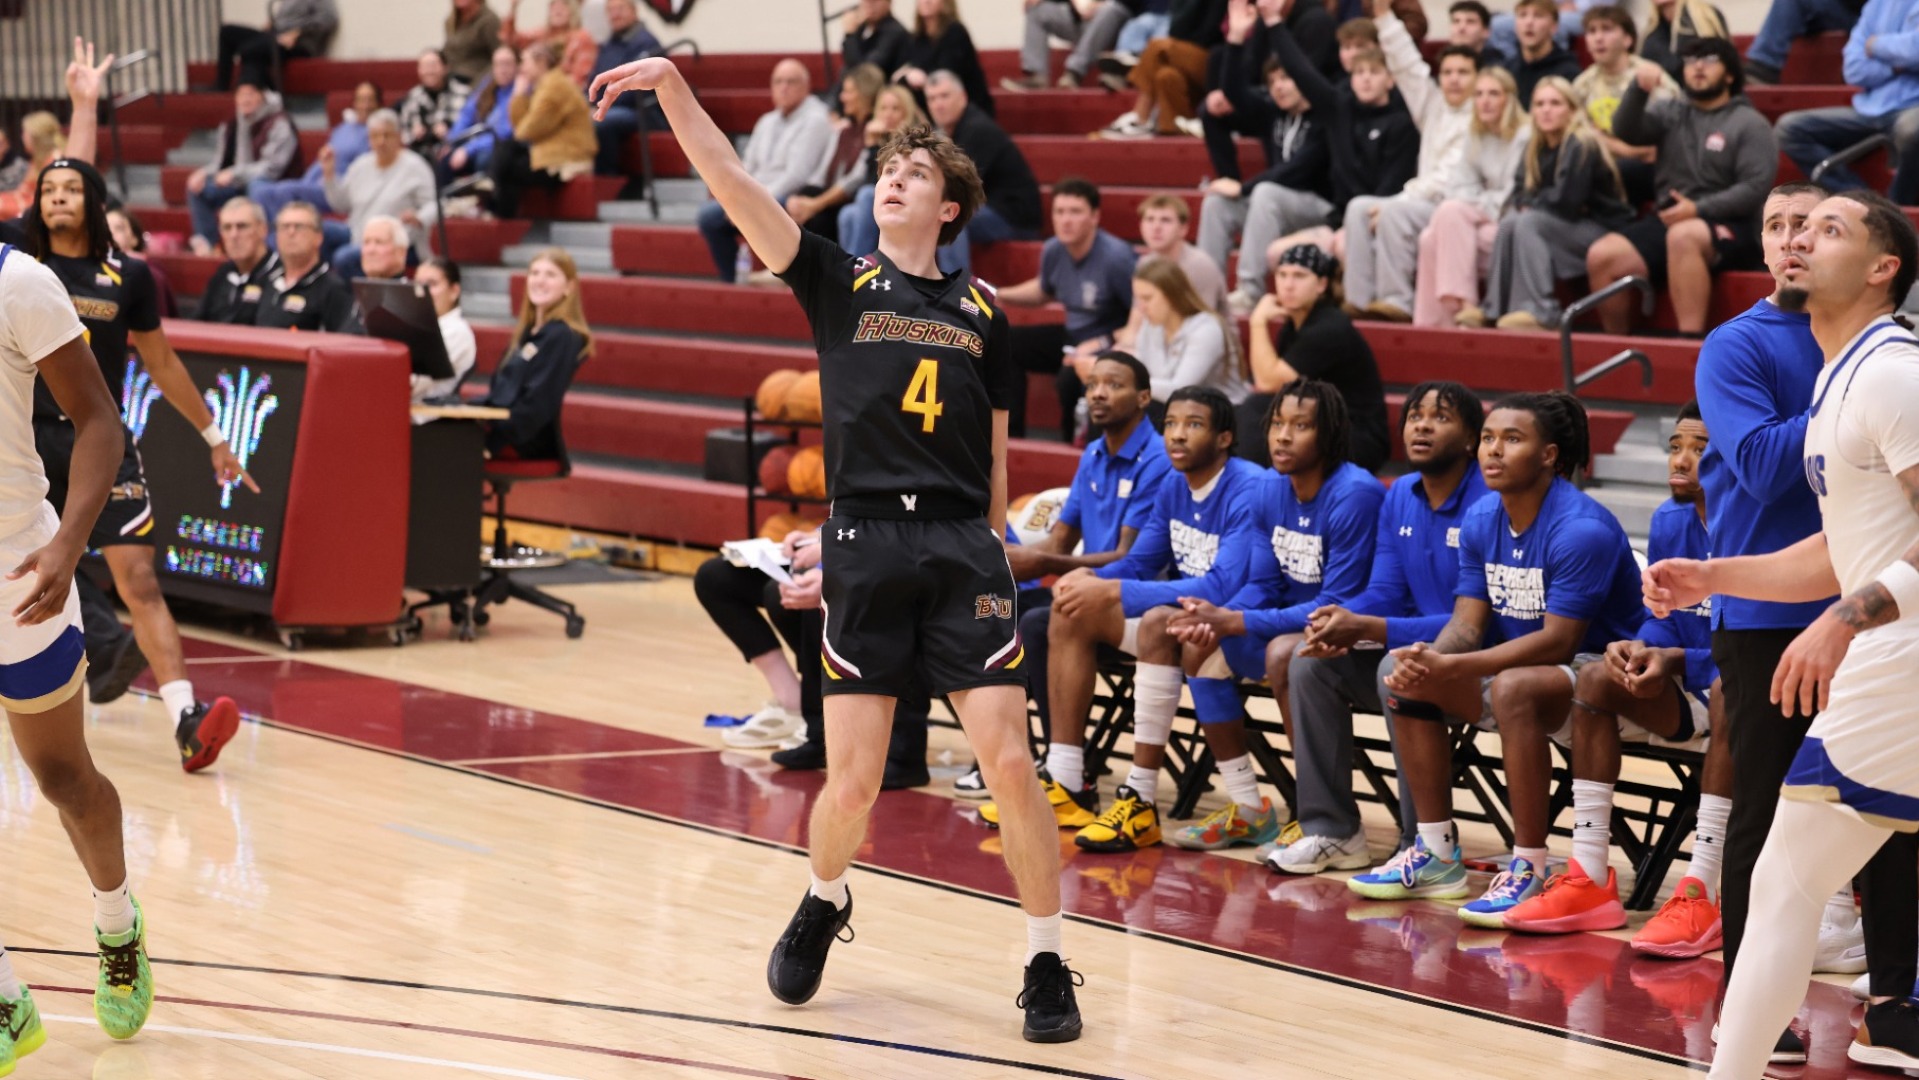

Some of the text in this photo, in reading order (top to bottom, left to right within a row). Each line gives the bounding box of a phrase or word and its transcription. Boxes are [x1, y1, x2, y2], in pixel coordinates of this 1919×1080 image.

[853, 311, 984, 358] HUSKIES
[901, 358, 944, 433] 4
[974, 594, 1012, 620] BU
